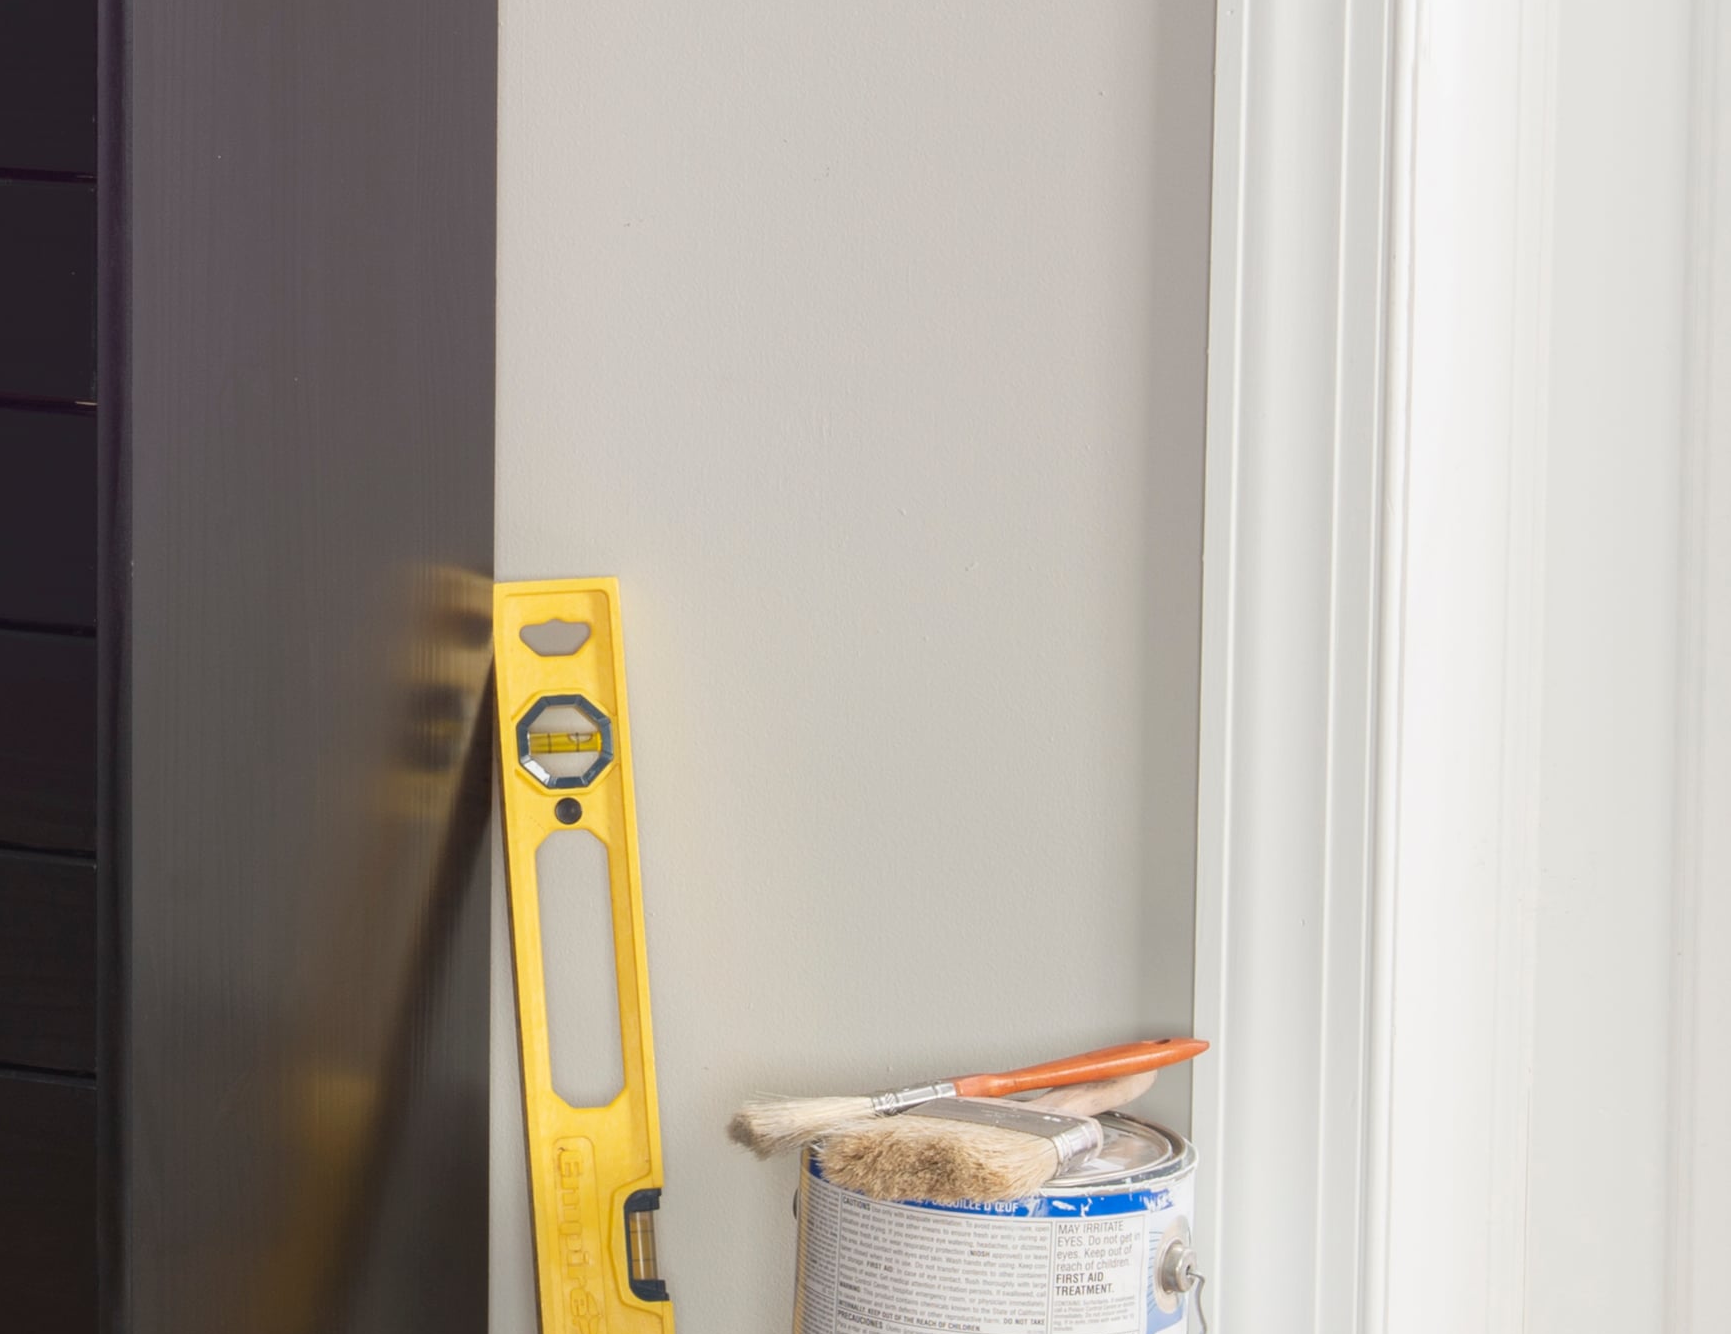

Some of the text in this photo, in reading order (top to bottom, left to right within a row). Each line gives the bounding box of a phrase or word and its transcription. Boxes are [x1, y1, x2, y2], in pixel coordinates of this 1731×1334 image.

[1058, 1220, 1124, 1234] MAY IRRITATE
[1088, 1234, 1101, 1246] Do
[1103, 1235, 1118, 1245] not
[1084, 1247, 1107, 1259] Keep
[1108, 1246, 1121, 1256] out
[1124, 1244, 1133, 1254] of
[1057, 1261, 1083, 1272] reach
[1085, 1261, 1094, 1271] of
[1056, 1271, 1104, 1284] FIRST AID
[1055, 1283, 1115, 1296] TREATMENT.
